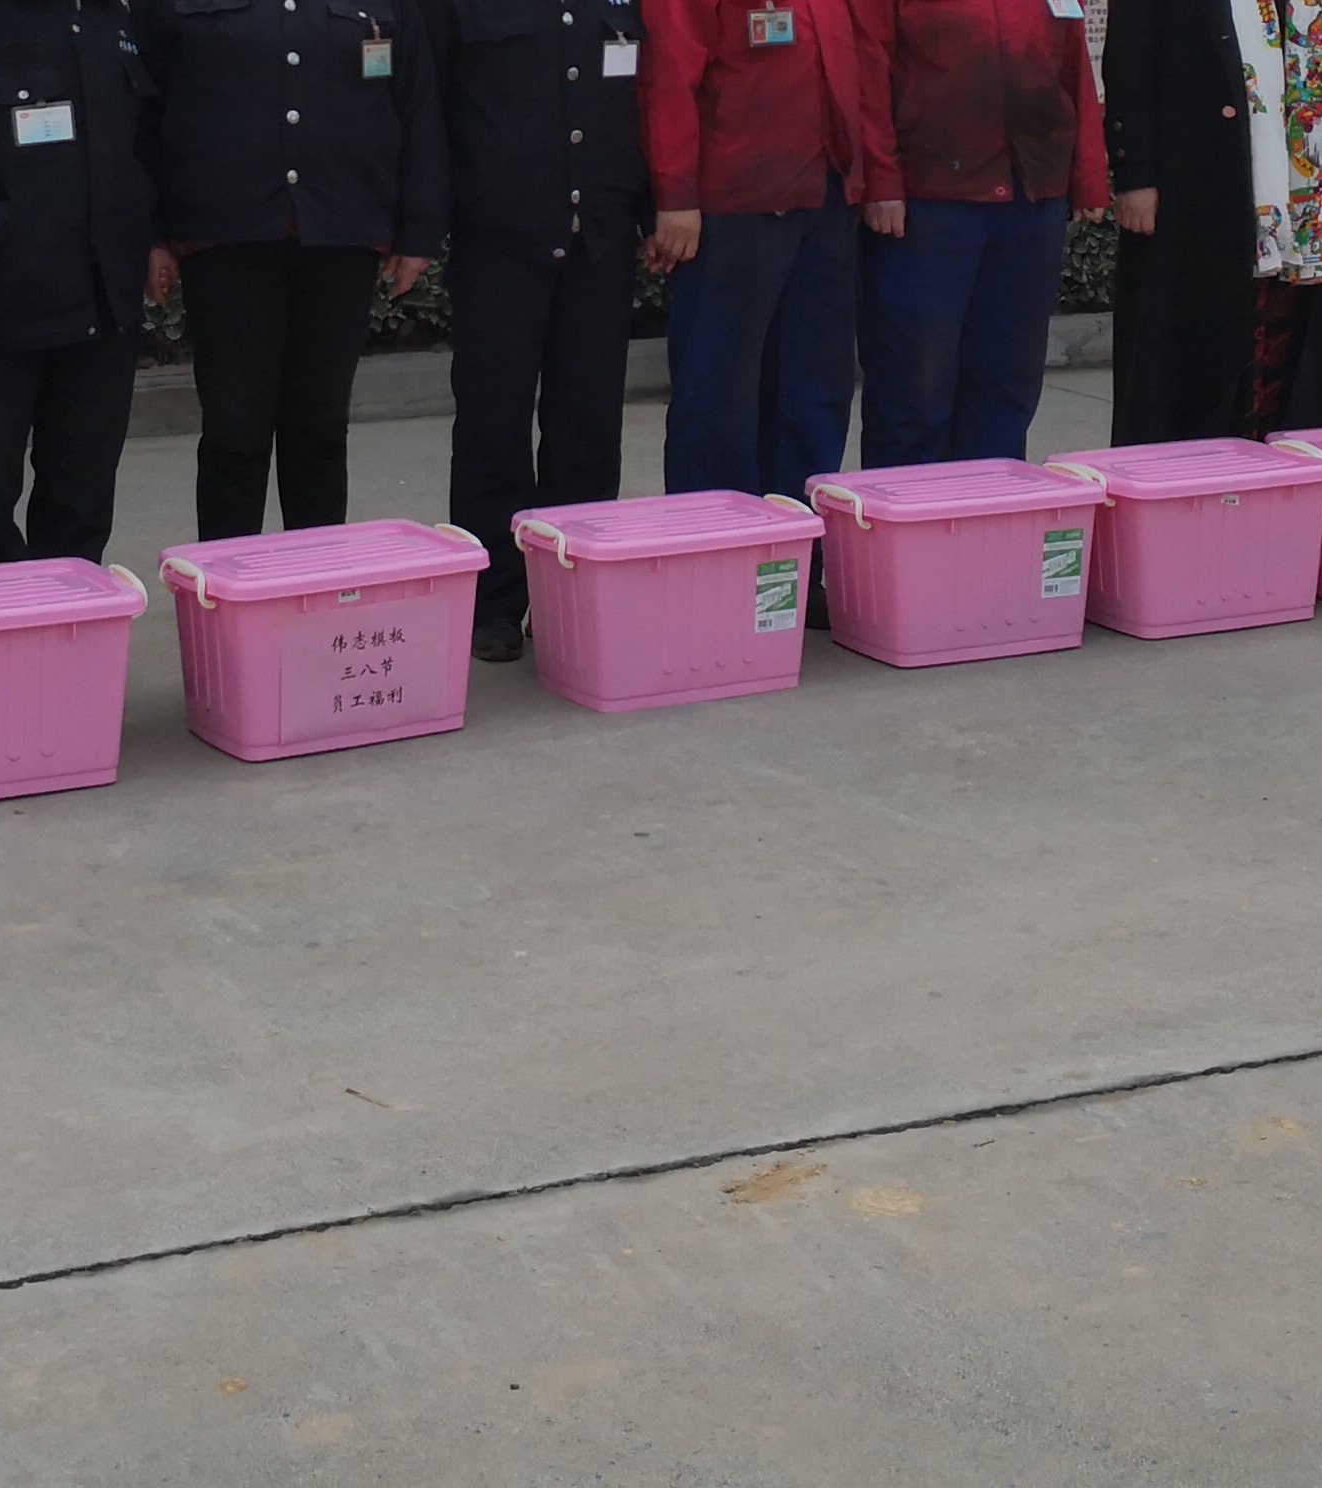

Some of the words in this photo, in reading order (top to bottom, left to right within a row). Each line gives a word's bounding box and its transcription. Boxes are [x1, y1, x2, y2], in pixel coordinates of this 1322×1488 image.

[332, 627, 406, 655] 伟志模板
[341, 656, 395, 681] 三八节
[333, 686, 404, 714] 员工福利
